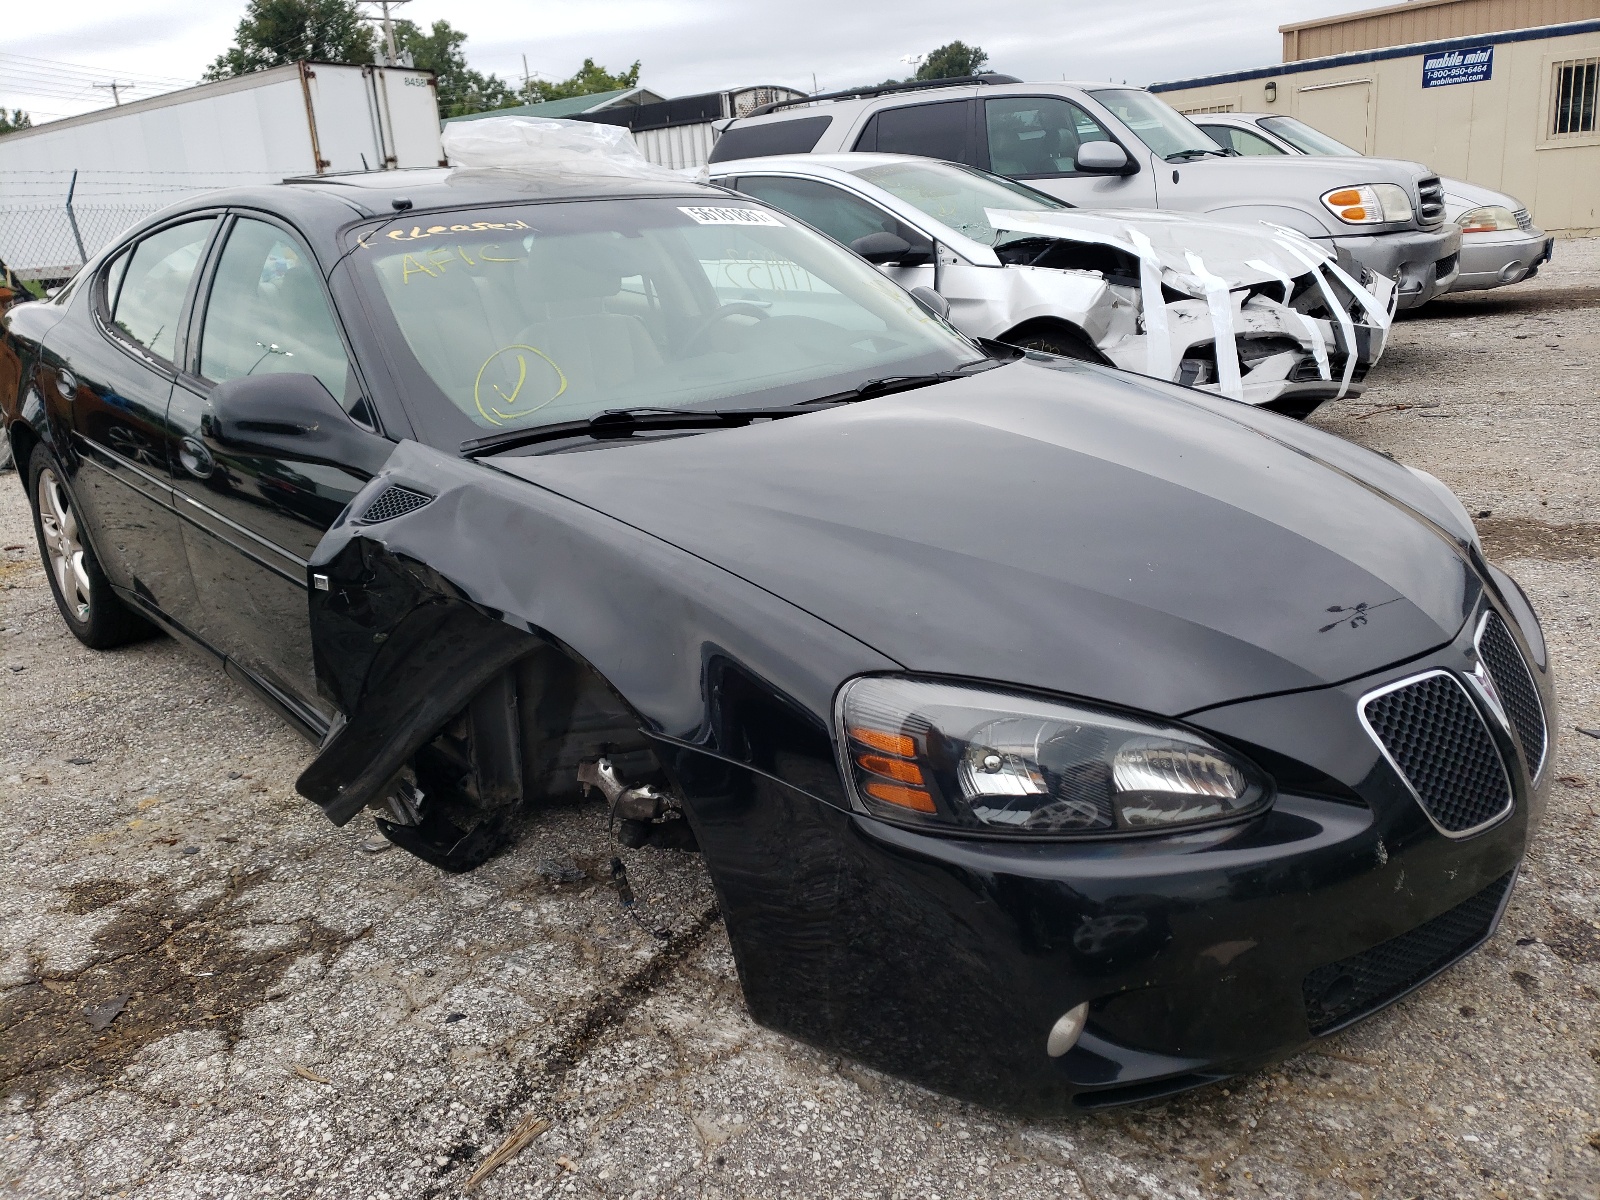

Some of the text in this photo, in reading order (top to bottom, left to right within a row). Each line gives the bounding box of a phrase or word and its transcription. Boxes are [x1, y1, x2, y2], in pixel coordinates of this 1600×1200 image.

[1425, 49, 1492, 69] mobile mini
[1427, 65, 1487, 79] 1-800-950-6464
[1430, 74, 1484, 86] mobilemini.com
